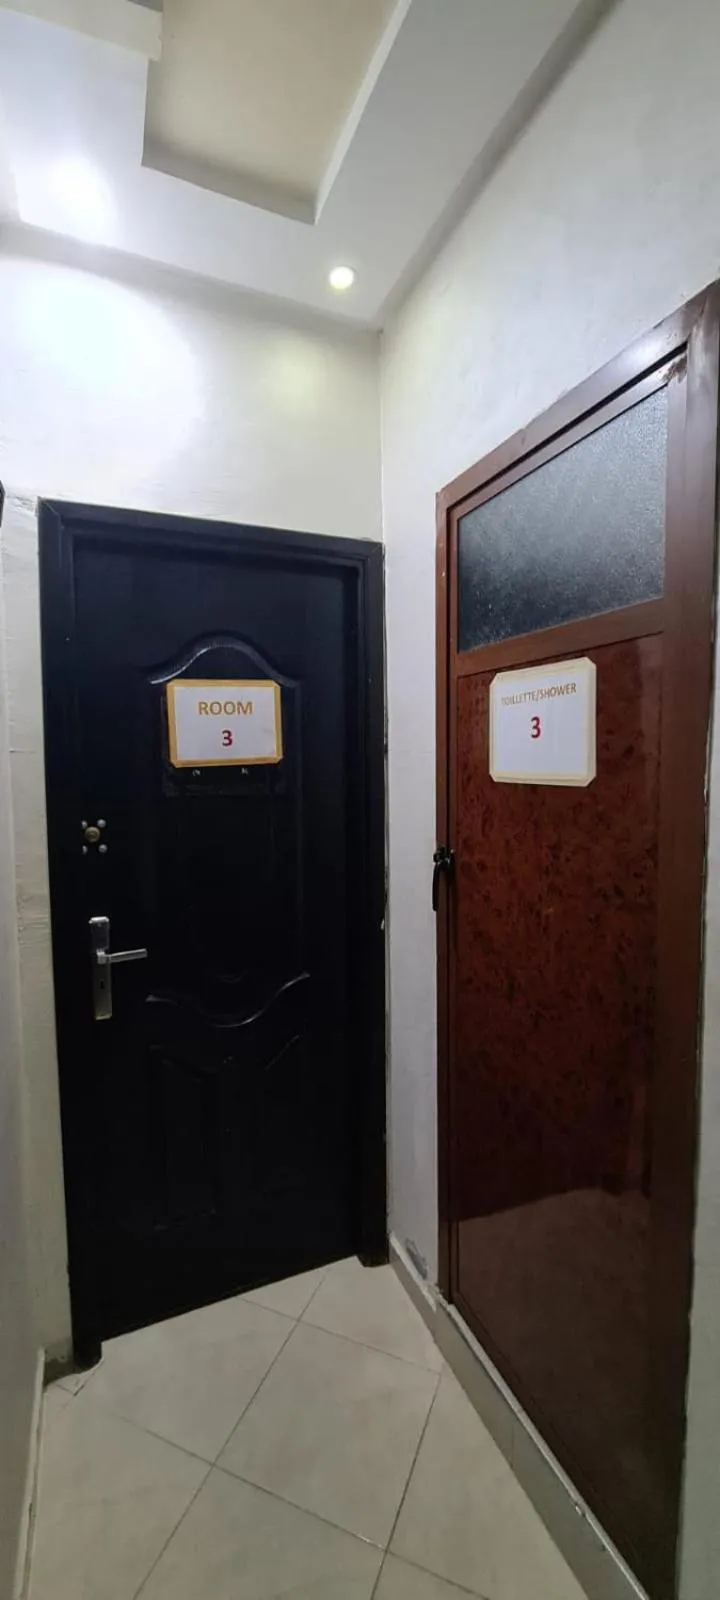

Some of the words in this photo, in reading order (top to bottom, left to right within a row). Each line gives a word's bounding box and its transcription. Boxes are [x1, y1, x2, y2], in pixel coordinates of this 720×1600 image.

[198, 701, 253, 715] ROOM
[531, 716, 541, 738] 3
[222, 729, 233, 747] 3
